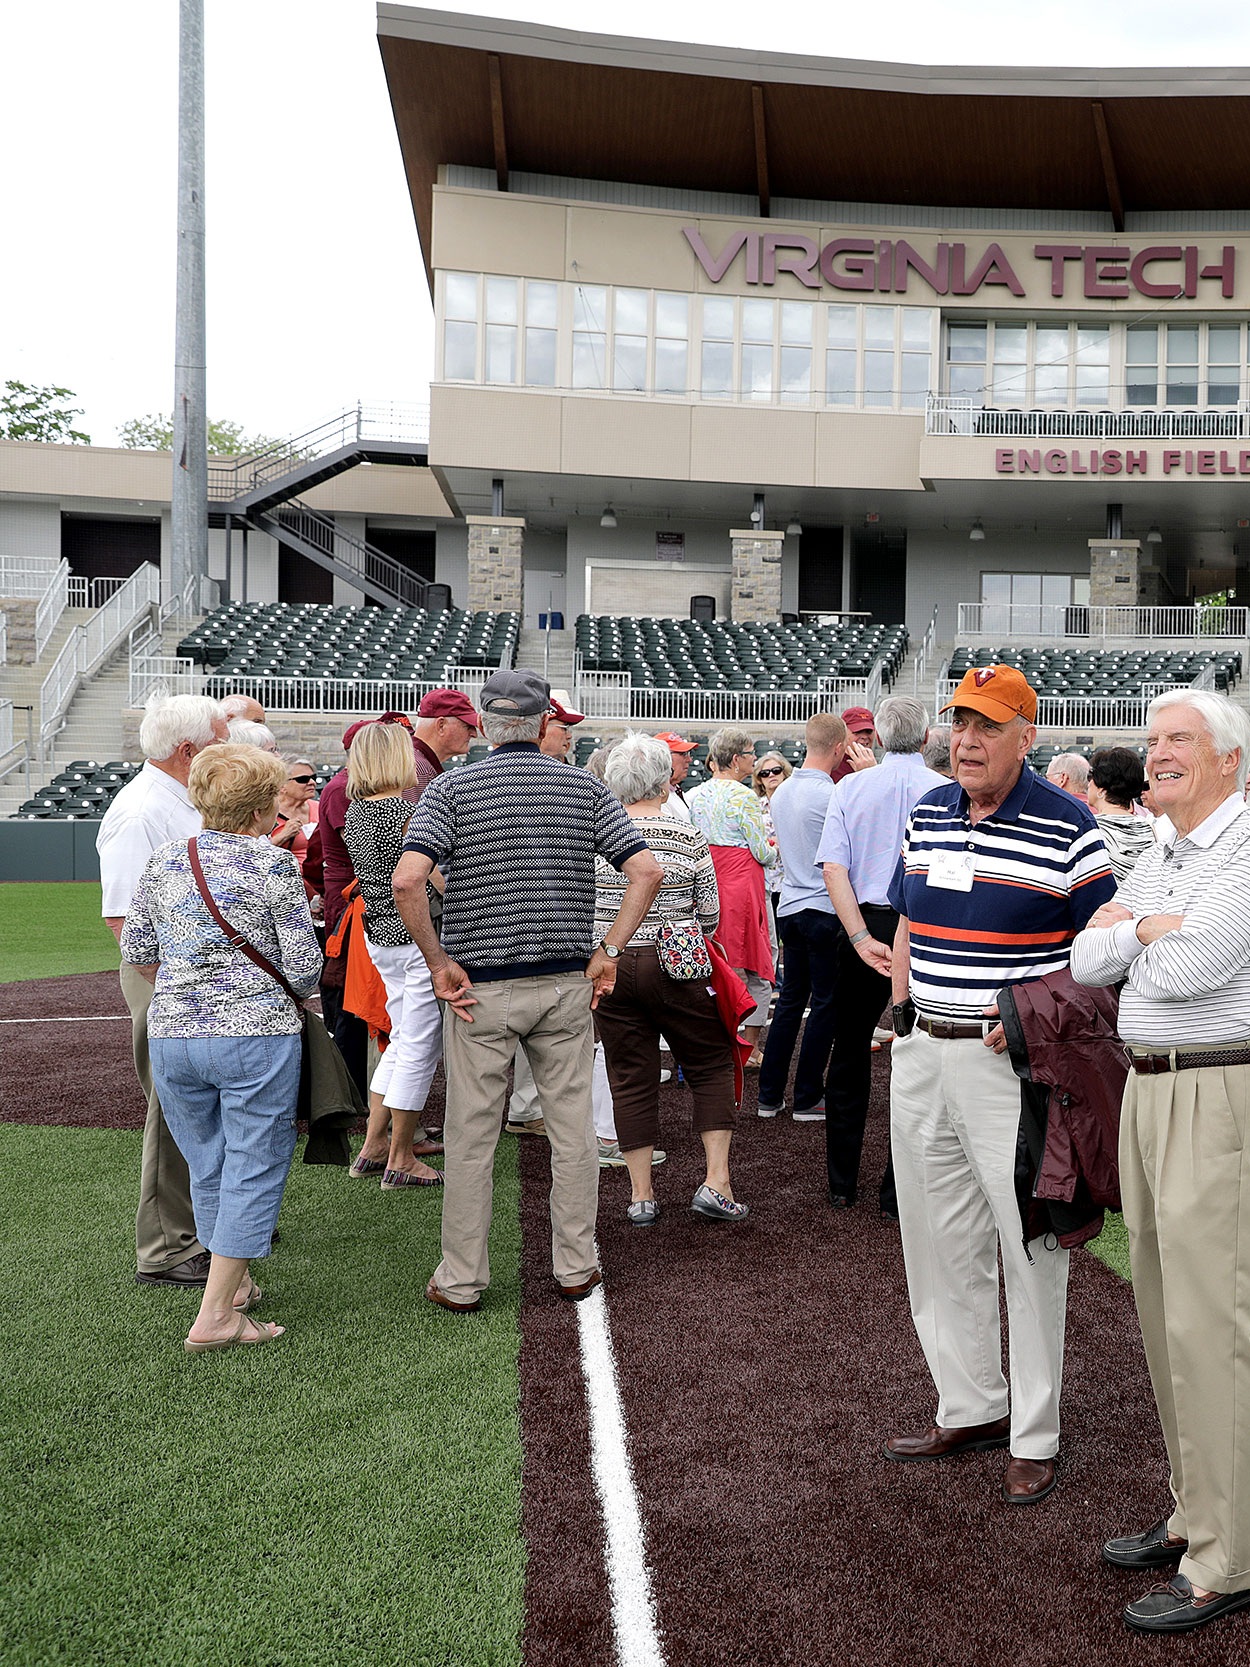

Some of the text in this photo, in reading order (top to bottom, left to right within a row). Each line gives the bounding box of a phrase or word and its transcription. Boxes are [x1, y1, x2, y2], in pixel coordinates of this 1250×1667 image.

[681, 226, 1236, 299] VIRGINIA TECH
[995, 448, 1148, 475] ENGLISH
